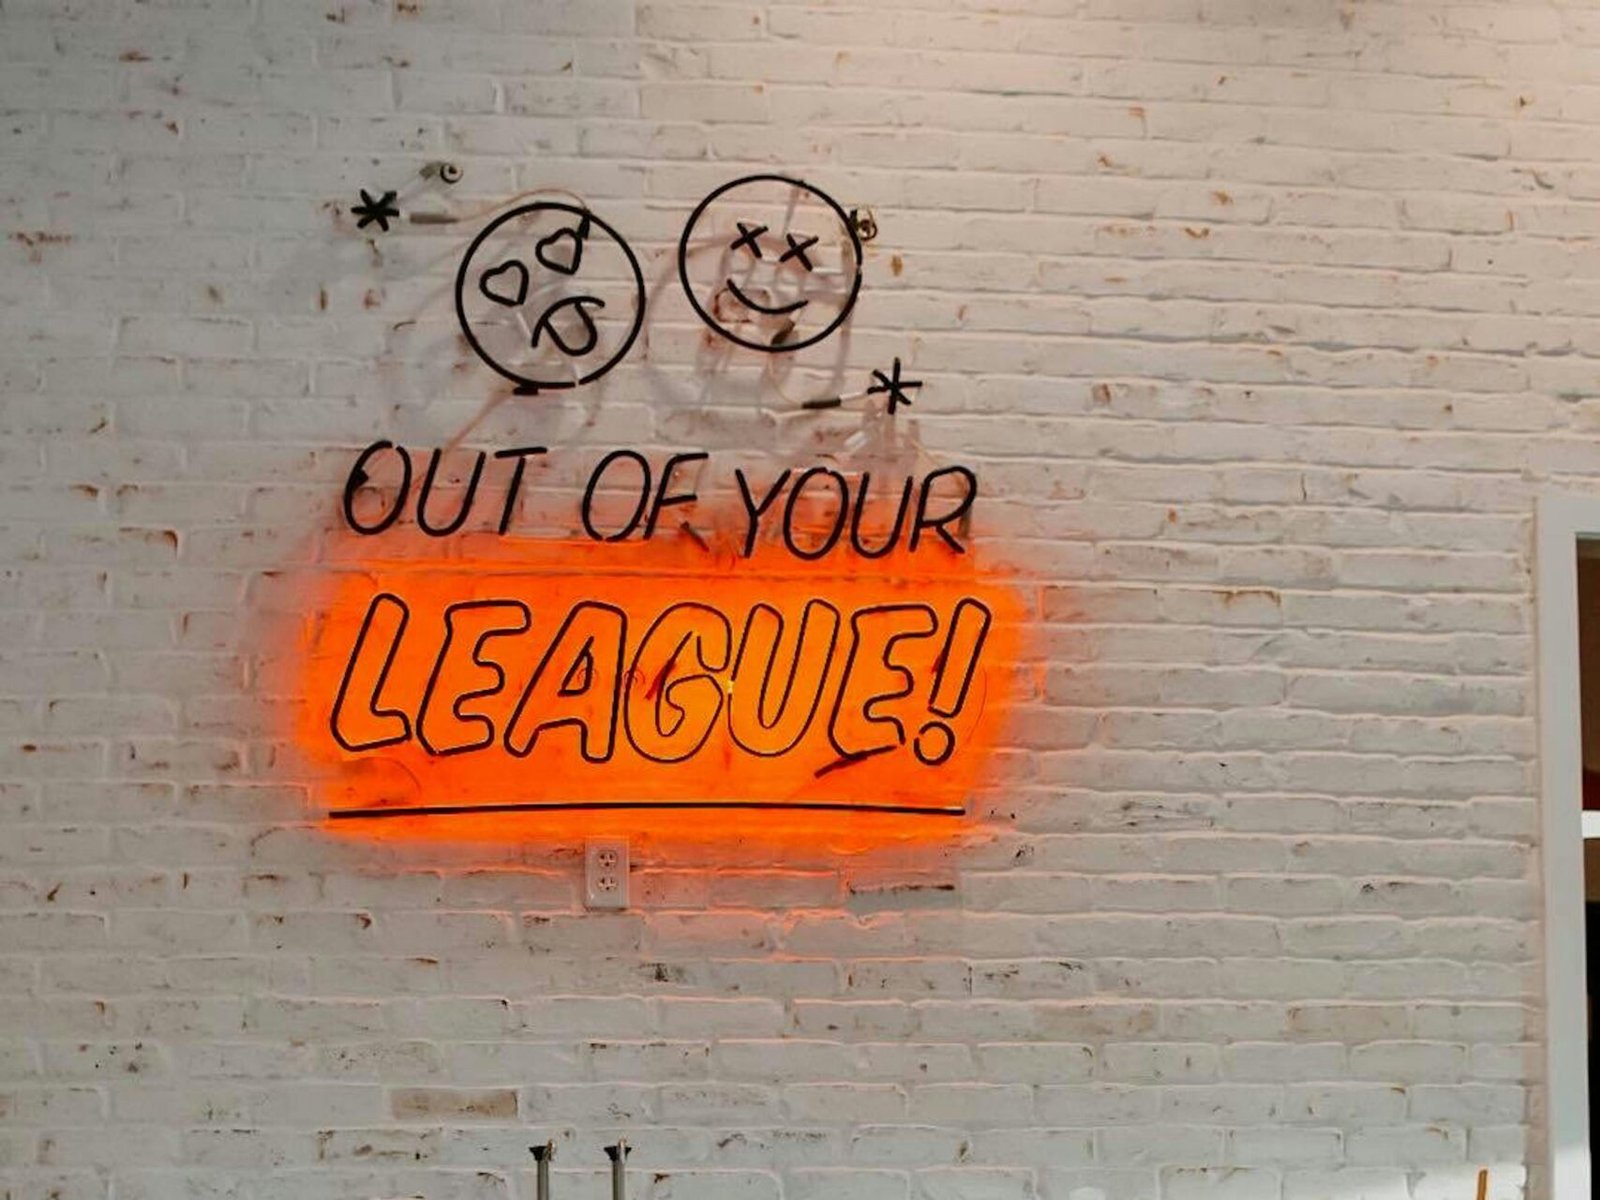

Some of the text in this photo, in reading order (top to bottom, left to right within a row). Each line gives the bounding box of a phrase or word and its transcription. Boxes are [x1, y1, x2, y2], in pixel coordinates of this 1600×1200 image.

[344, 440, 978, 560] OUT OF YOUR
[329, 593, 992, 765] LEAGUE!
